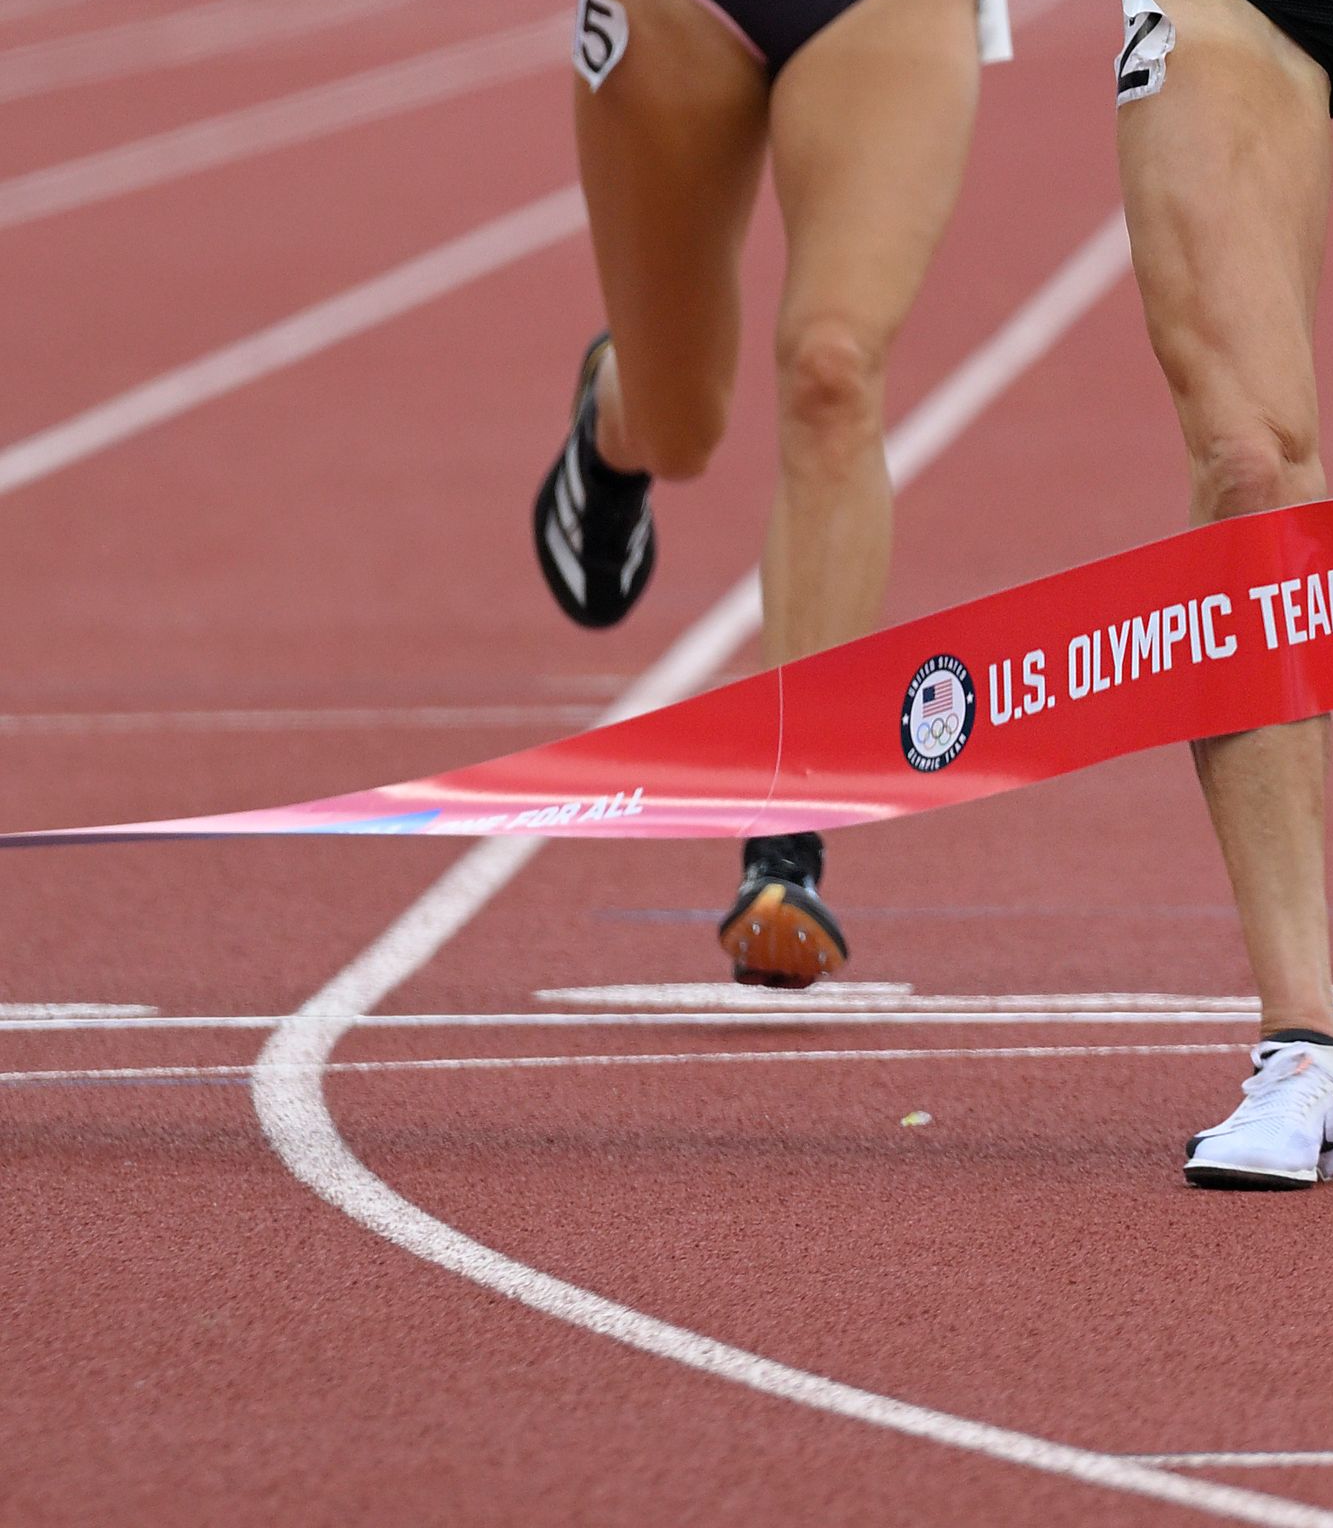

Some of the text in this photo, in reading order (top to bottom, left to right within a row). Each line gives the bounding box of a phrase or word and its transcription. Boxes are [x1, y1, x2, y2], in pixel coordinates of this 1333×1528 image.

[989, 648, 1057, 727] U.S.
[1067, 592, 1239, 700] OLYMPIC
[505, 800, 583, 829] FOR
[579, 786, 644, 823] ALL
